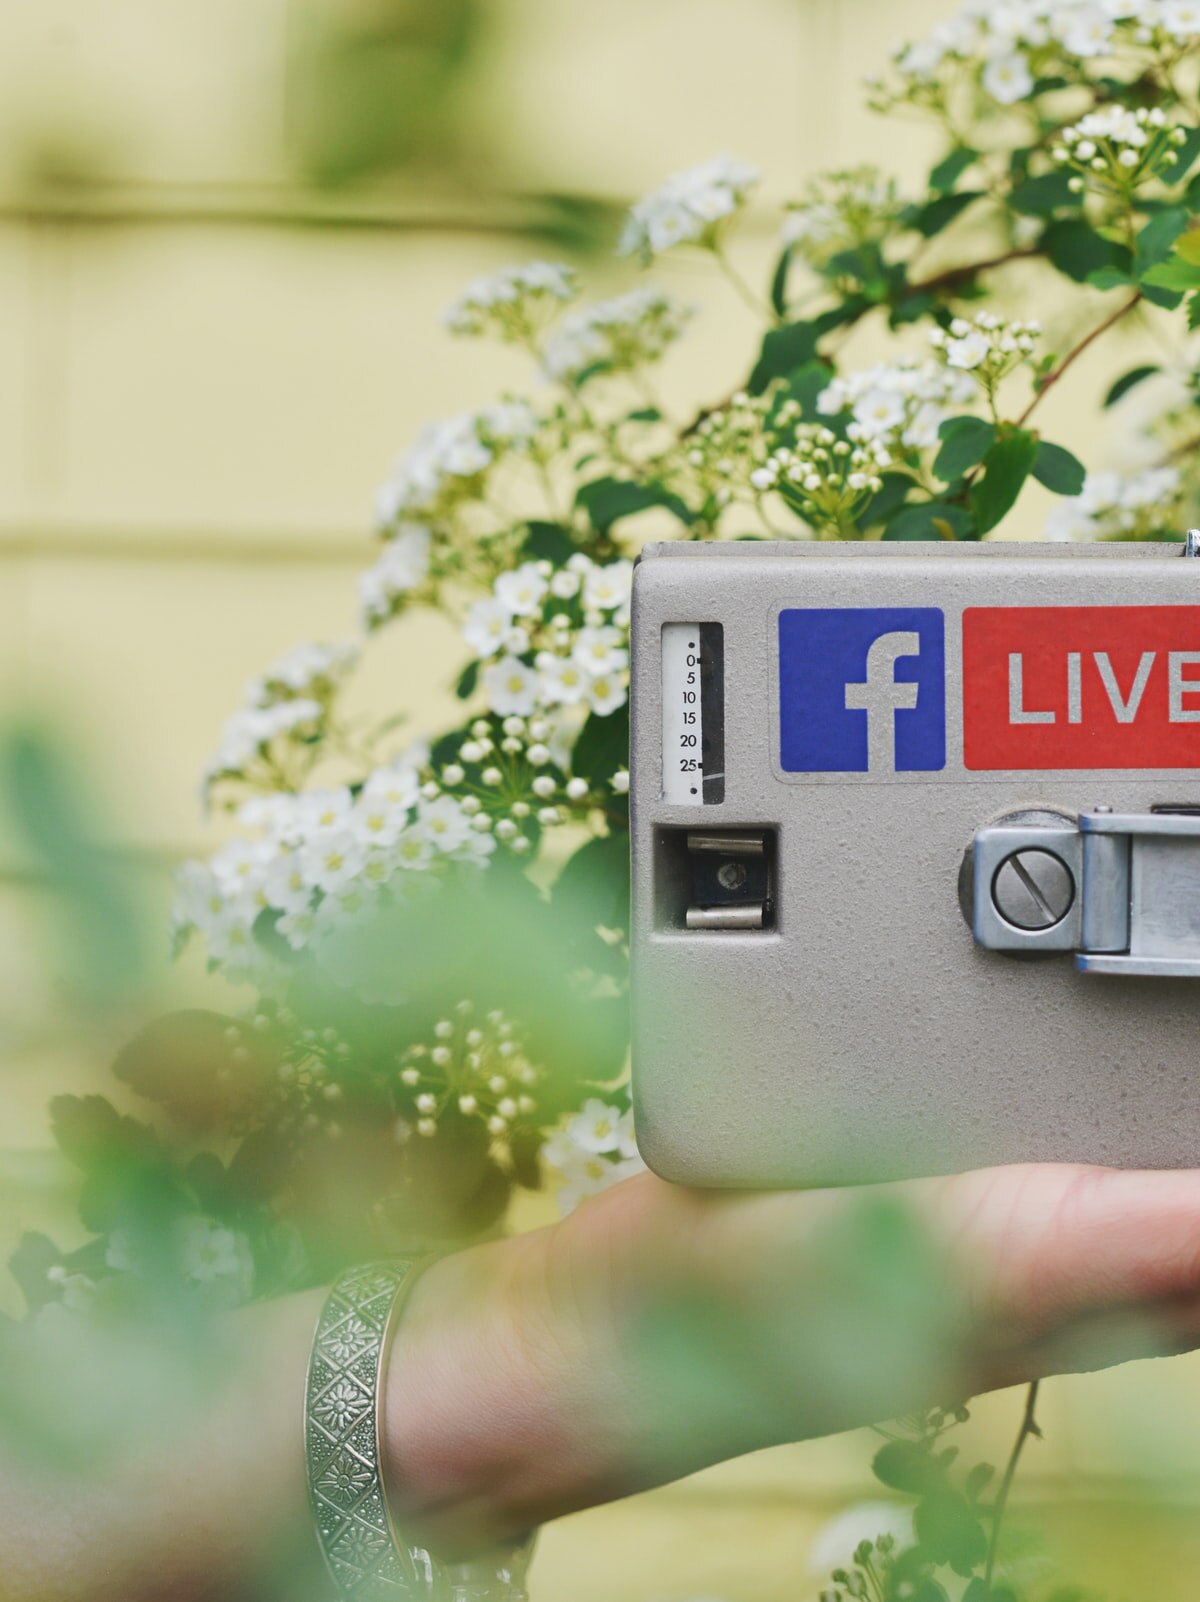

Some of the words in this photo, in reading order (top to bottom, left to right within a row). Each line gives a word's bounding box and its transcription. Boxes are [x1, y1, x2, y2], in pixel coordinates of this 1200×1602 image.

[686, 654, 696, 667] 0
[686, 672, 696, 684] 5
[682, 691, 697, 704] 10
[845, 631, 920, 772] f
[682, 712, 697, 724] 15
[679, 735, 697, 747] 20
[679, 759, 697, 772] 25
